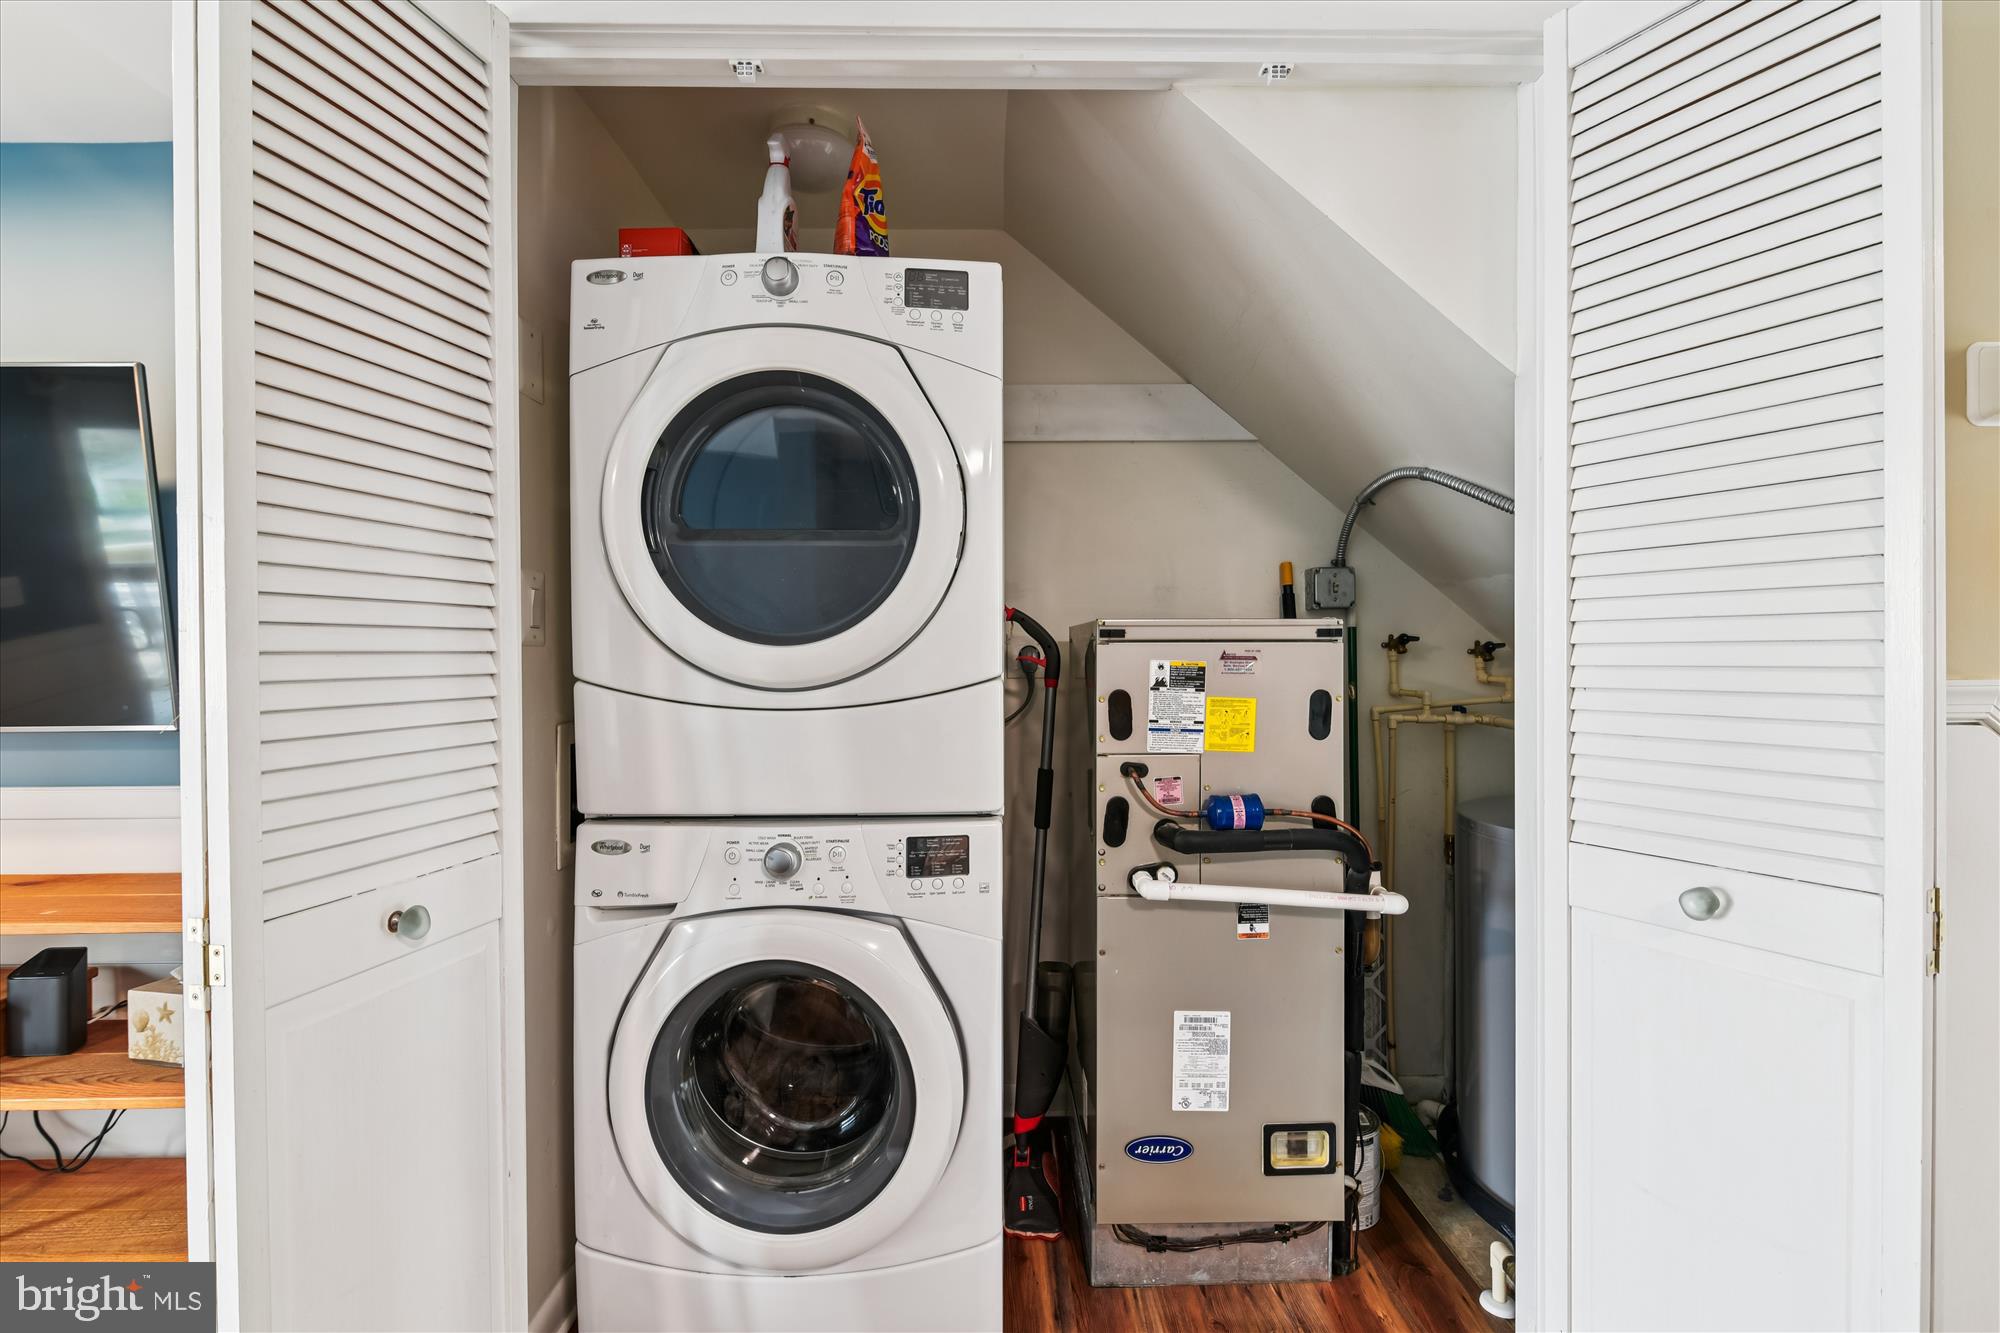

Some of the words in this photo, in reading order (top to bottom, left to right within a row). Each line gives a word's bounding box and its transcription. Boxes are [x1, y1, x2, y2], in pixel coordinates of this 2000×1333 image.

[859, 187, 885, 217] Tid
[599, 844, 624, 852] Whirlpool
[1135, 1145, 1185, 1157] Carrier
